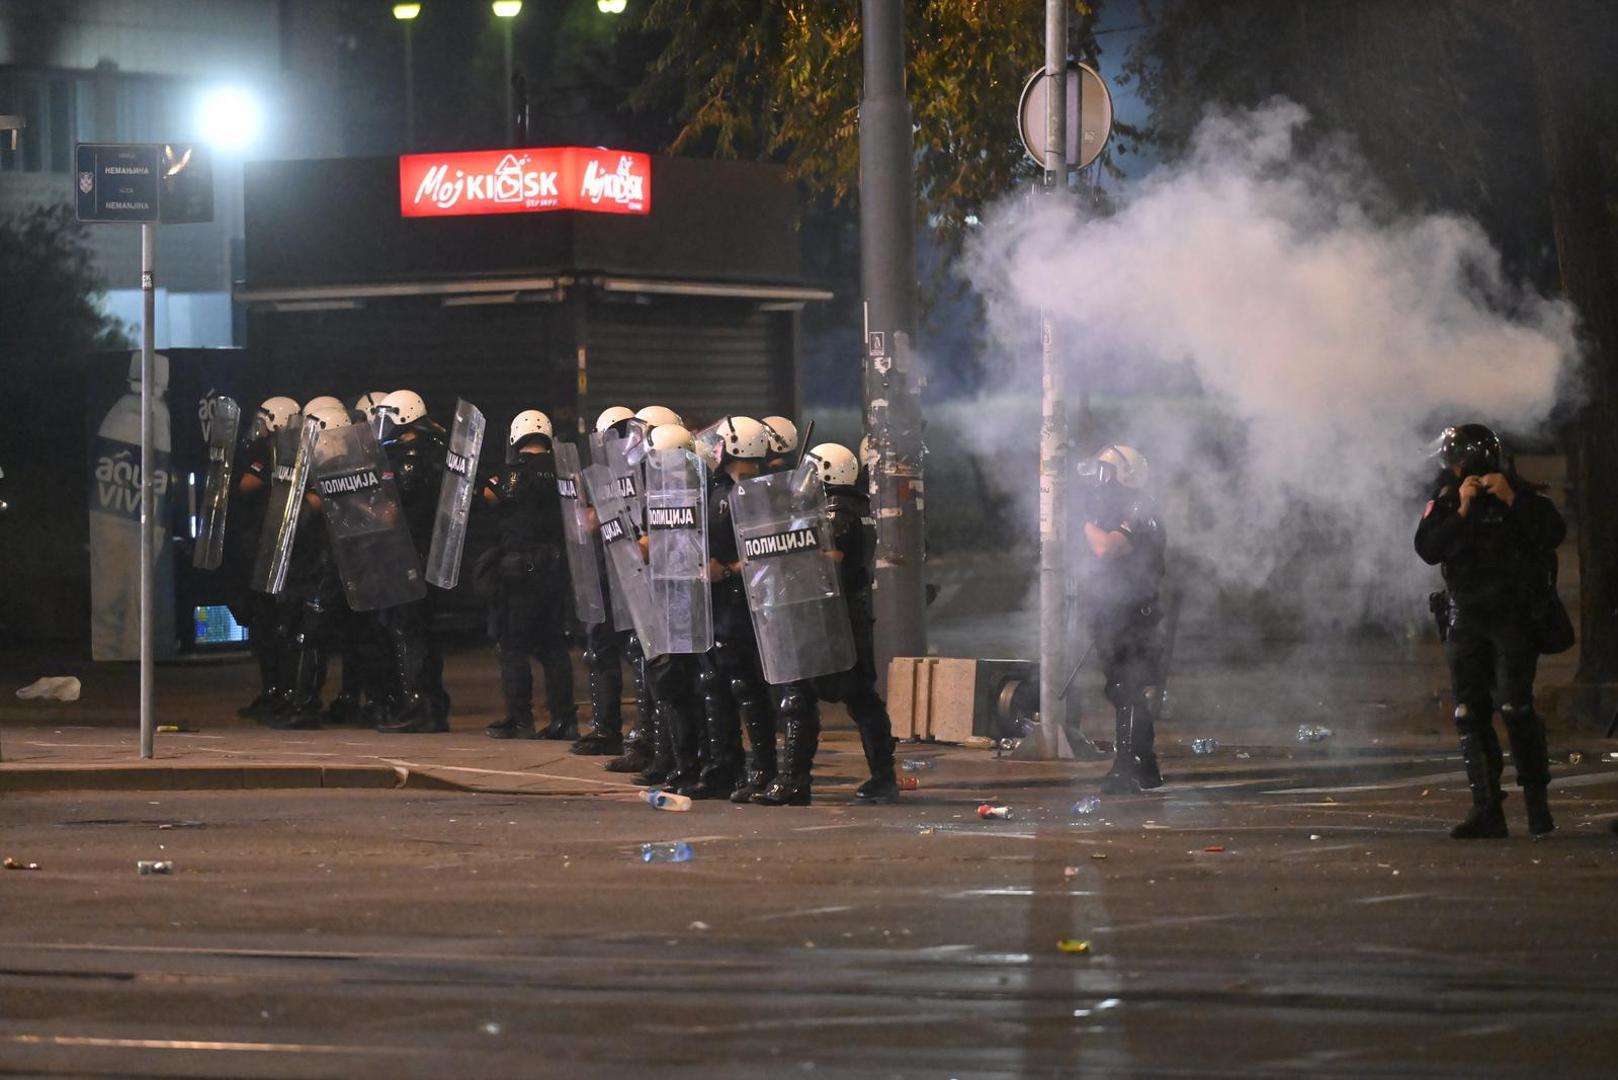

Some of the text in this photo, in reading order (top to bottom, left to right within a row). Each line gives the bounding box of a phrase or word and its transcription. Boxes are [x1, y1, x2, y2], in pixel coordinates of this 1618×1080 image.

[414, 164, 464, 208] Moj
[98, 482, 159, 514] VIV
[745, 530, 817, 557] ПОЛИЦИЈА
